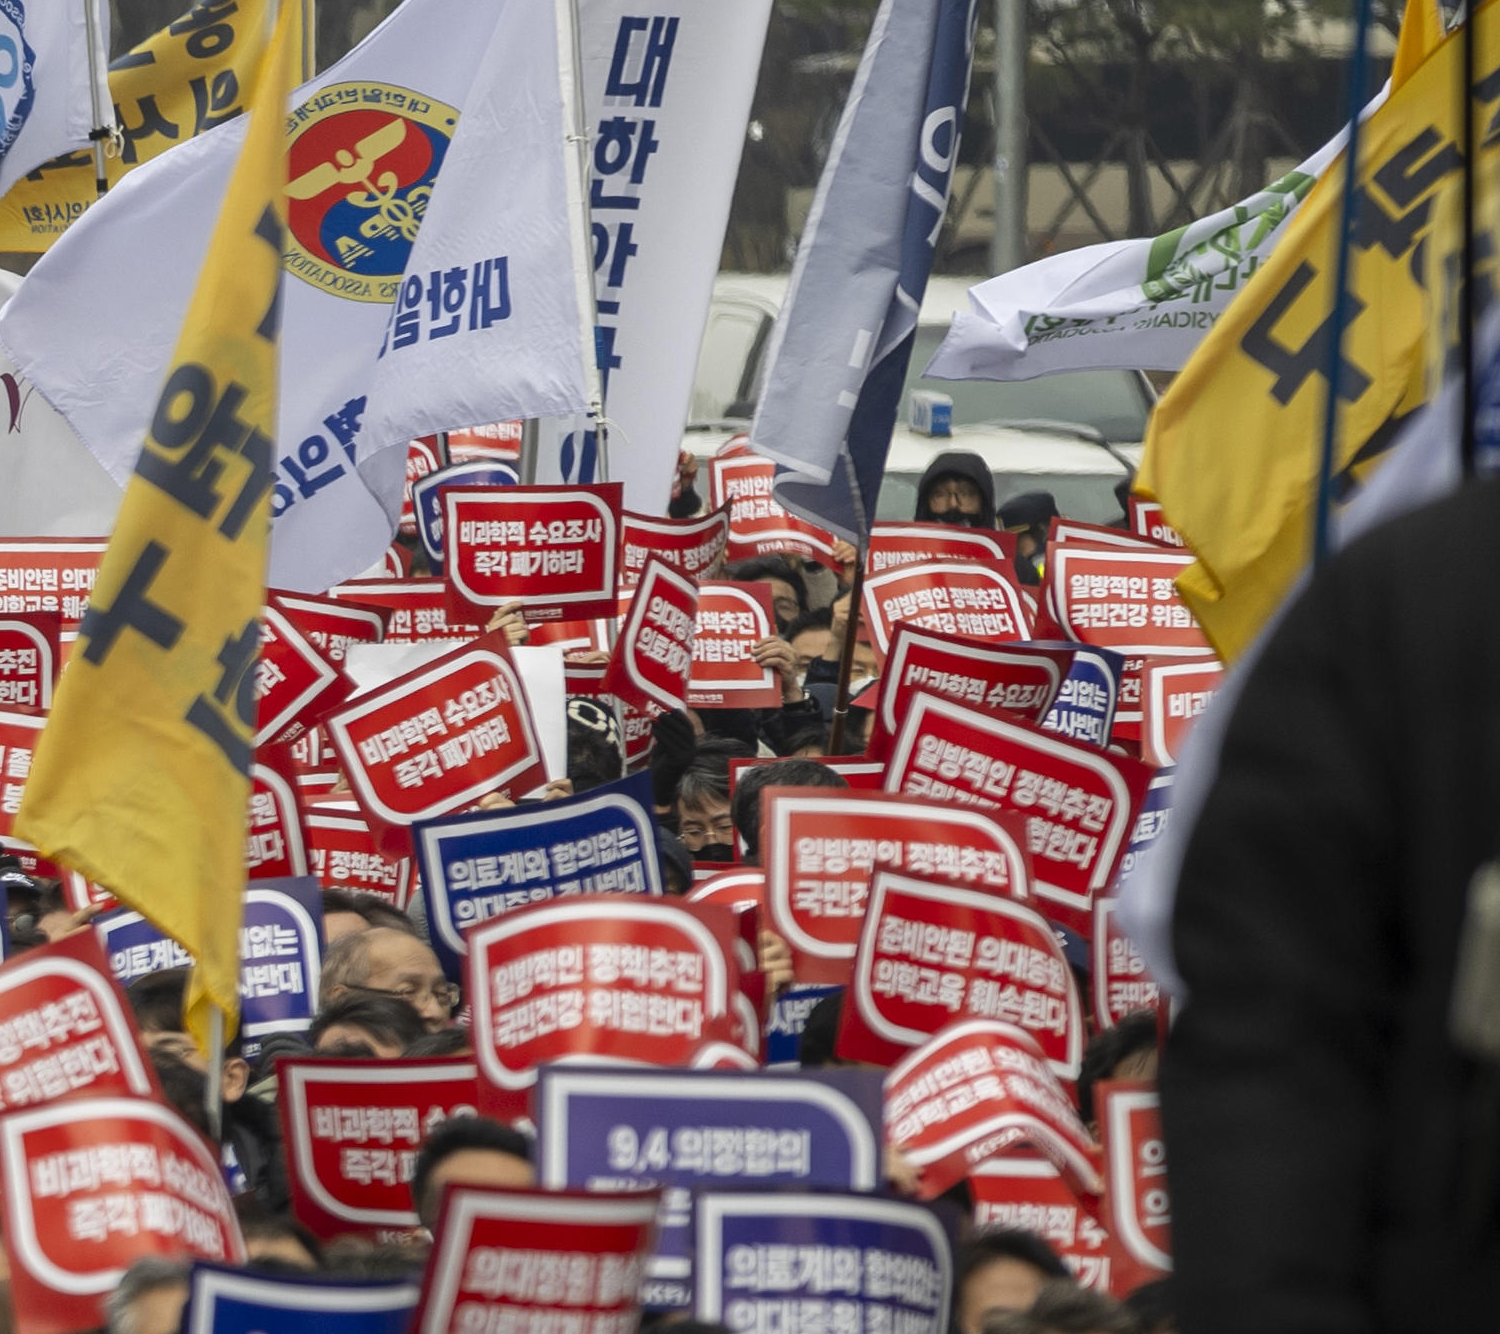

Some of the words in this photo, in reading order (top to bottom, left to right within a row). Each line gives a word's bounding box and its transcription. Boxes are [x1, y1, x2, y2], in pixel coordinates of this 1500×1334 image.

[459, 520, 524, 548] 비과학적
[528, 517, 603, 546] 수요조사
[918, 733, 1016, 797] 일방적인
[1016, 769, 1114, 833] 정책추진
[448, 846, 550, 894] 의료계와
[551, 822, 638, 872] 합의없는
[492, 950, 588, 1001] 일방적인
[589, 931, 703, 986] 정책추진
